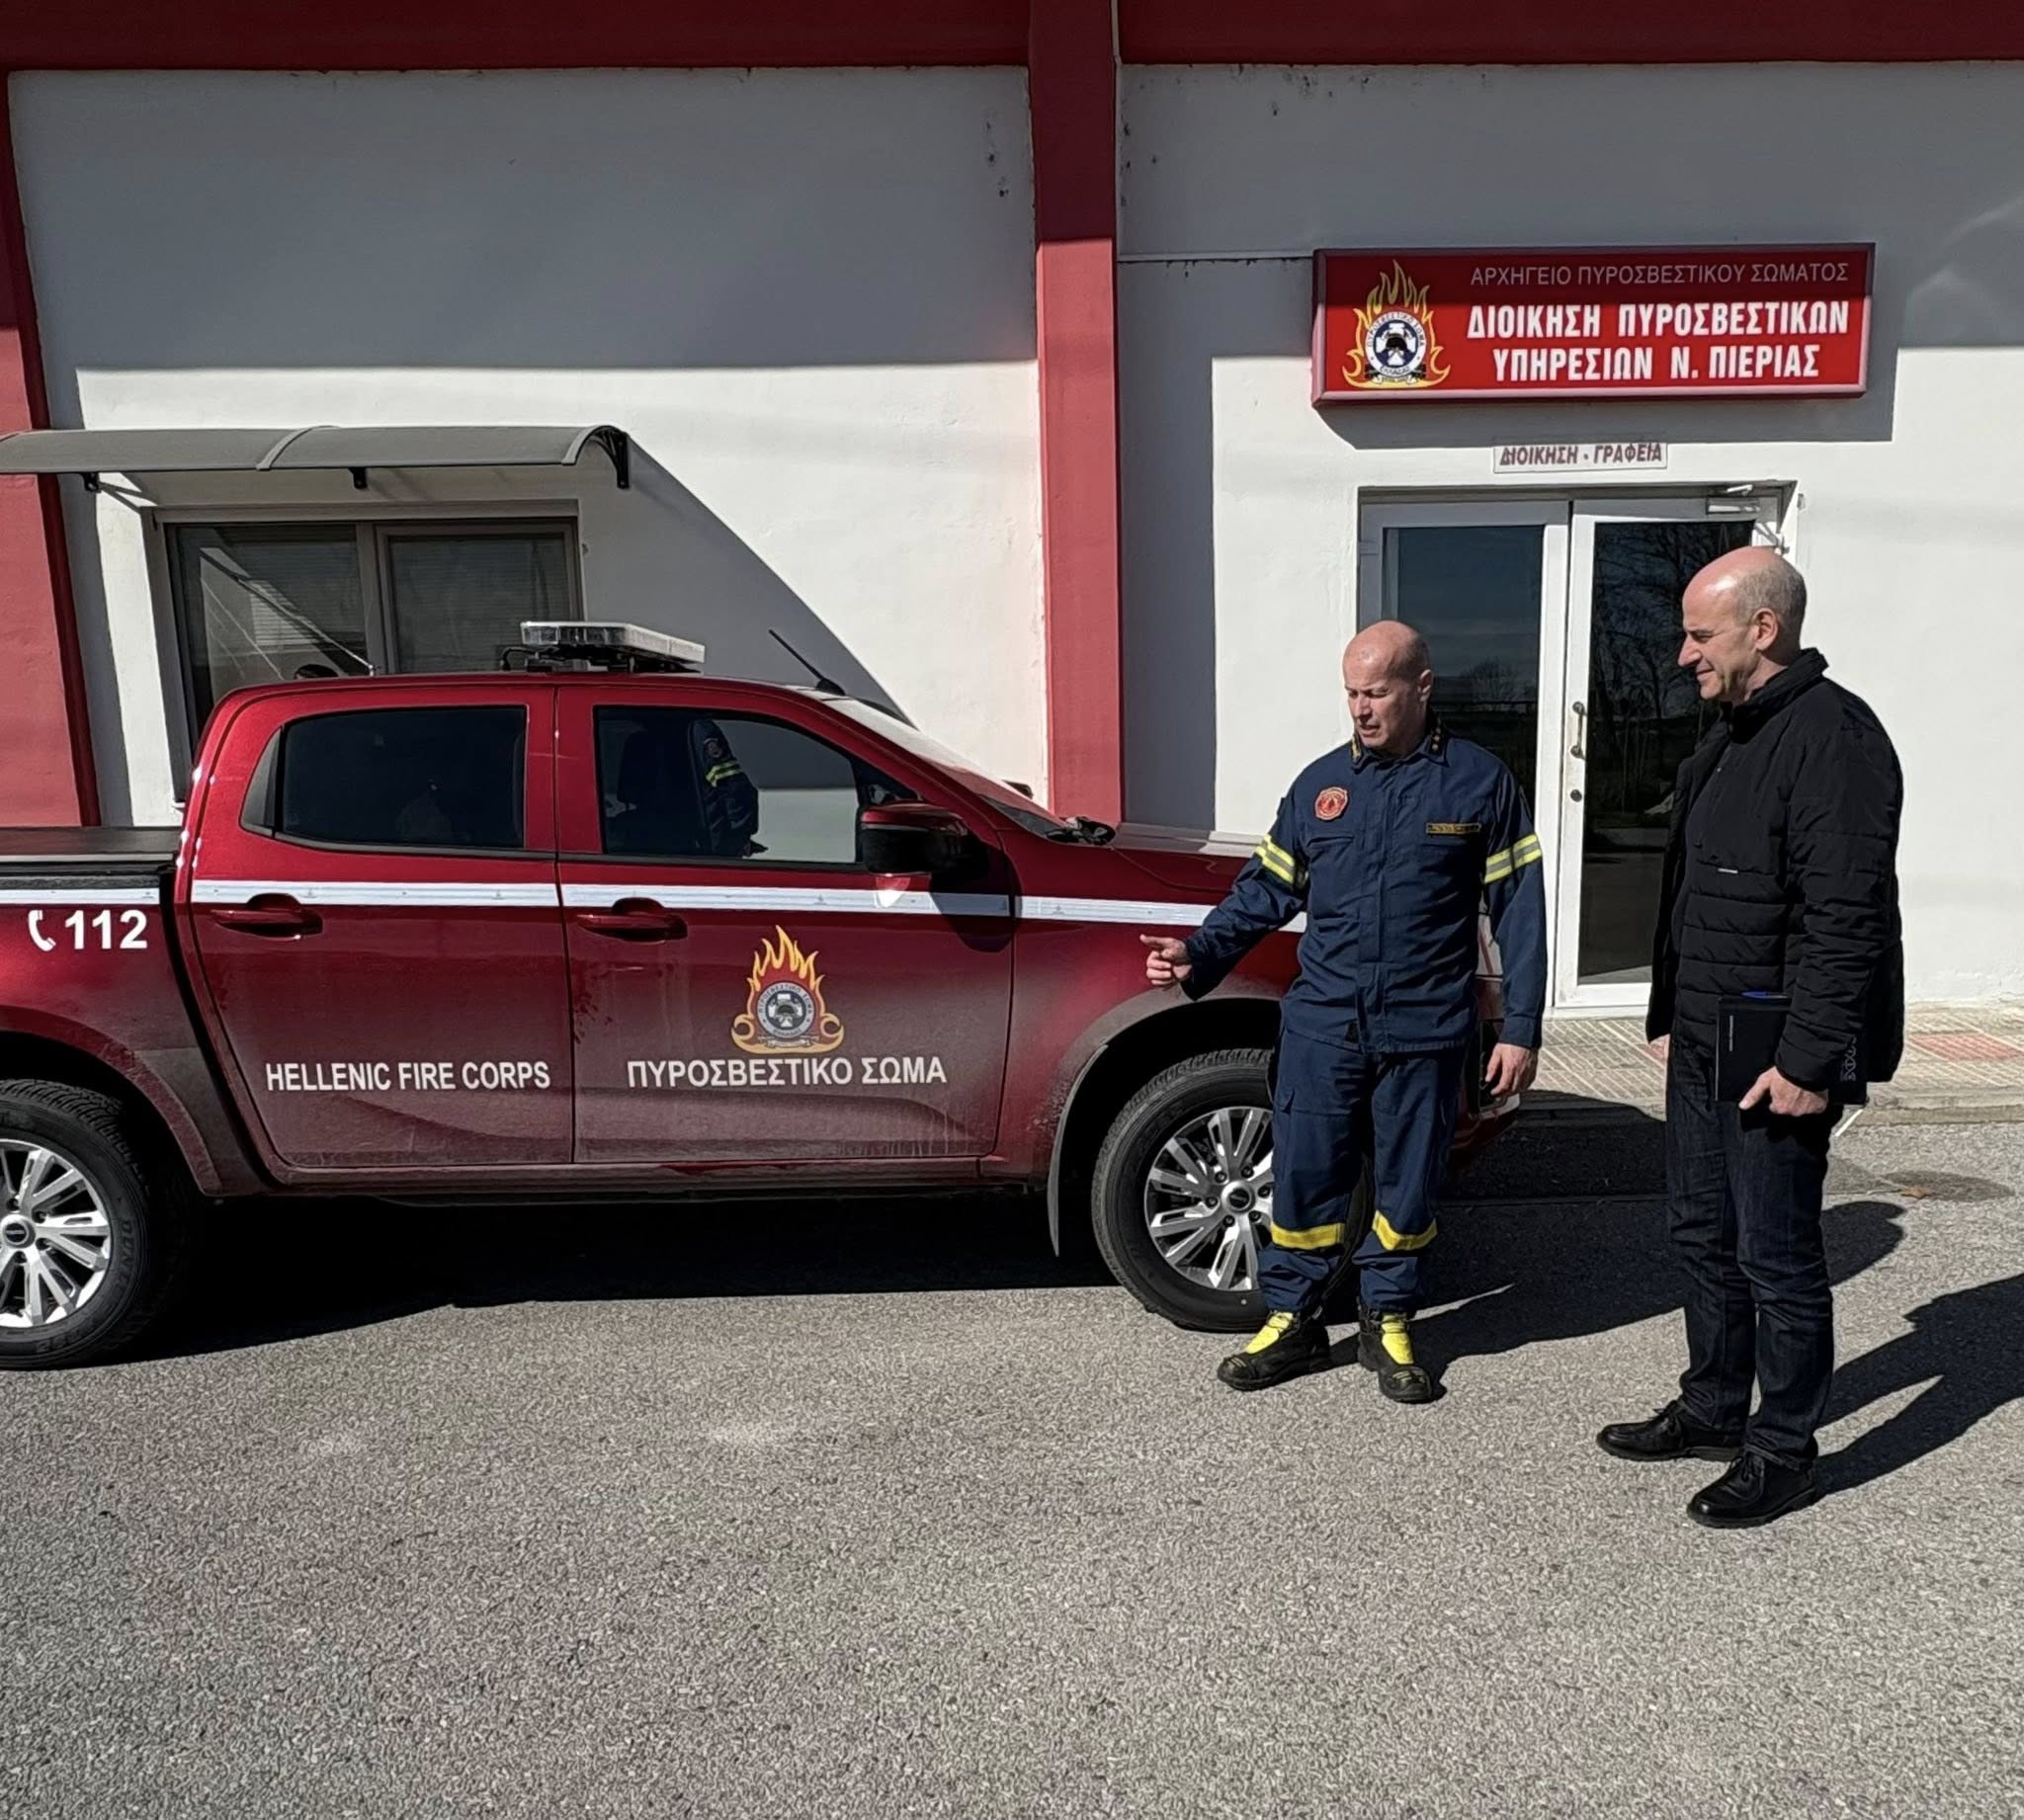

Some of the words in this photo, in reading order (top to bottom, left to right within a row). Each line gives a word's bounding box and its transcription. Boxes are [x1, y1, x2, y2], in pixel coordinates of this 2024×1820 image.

[1471, 266, 1572, 287] ΑΡΧΗΓΕΙΟ
[1578, 264, 1744, 285] ΠΥΡΟΣΒΕΣΤΙΚΟΥ
[1750, 262, 1849, 283] ΣΩΜΑΤΟΣ
[1467, 304, 1601, 339] ΔΙΟΙΚΗΣΗ
[1618, 300, 1849, 337] ΠΥΡΟΣΒΕΣΤΙΚΩΝ
[1492, 348, 1652, 381] ΥΠΗΡΕΣΙΩΝ
[1670, 347, 1699, 379] Ν.
[1708, 345, 1820, 378] ΠΙΕΡΙΑΣ
[1499, 446, 1578, 465] ΔΙΟΙΚΗΣΗ
[1593, 444, 1662, 463] ΓΡΑΦΕΙΑ
[65, 910, 147, 950] 112
[265, 1062, 391, 1092] HELLENIC
[398, 1062, 456, 1090] FIRE
[462, 1061, 550, 1089] CORPS
[628, 1057, 852, 1087] ΠΥΡΟΣΒΕΣΤΙΚΟ
[861, 1056, 947, 1084] ΣΩΜΑ
